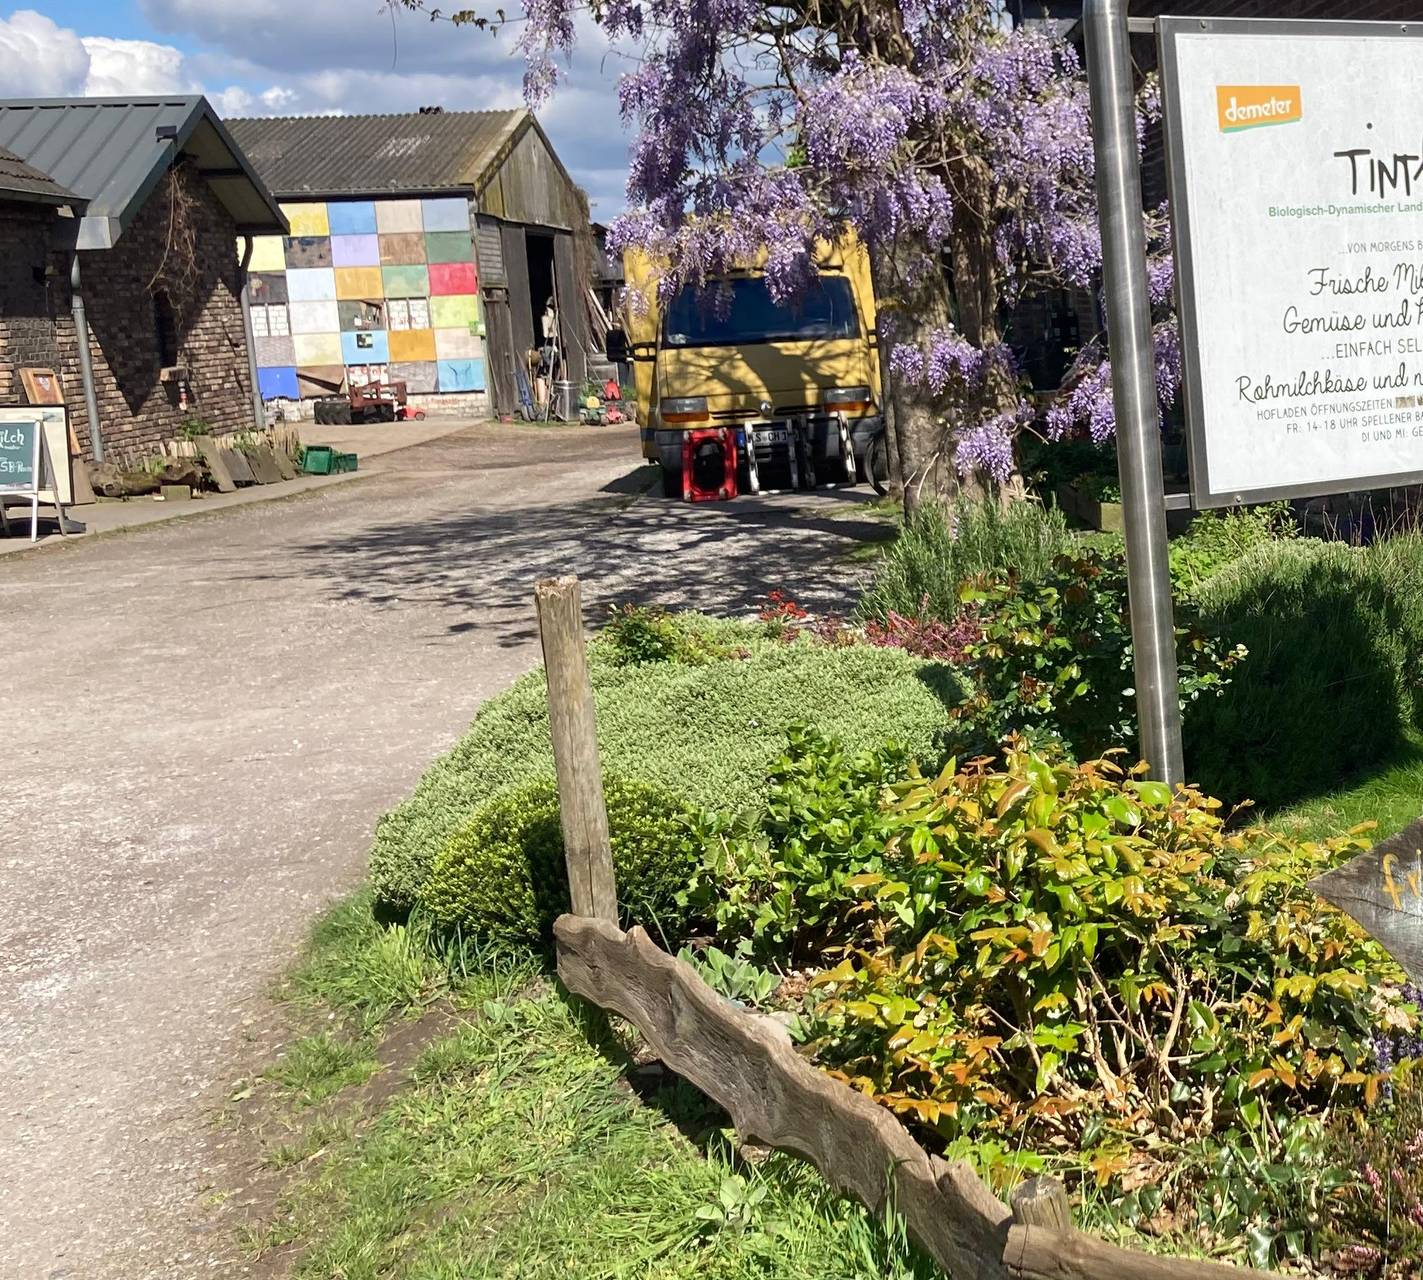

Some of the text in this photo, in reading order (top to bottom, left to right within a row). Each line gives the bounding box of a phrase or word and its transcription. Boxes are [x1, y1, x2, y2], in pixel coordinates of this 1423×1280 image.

[1225, 96, 1292, 122] demeter
[1268, 203, 1395, 219] Biologisch-Dynamischer
[1370, 240, 1415, 252] MORGENS
[1307, 266, 1389, 296] Frische
[1283, 305, 1366, 334] Gemüse
[1372, 299, 1412, 329] und
[1321, 340, 1392, 360] ...EINFACH
[1235, 368, 1368, 404] Rohmilchkäse
[1373, 361, 1409, 390] und
[1256, 398, 1393, 421] HOFLADEN ÖFFNUNGSZEITEN
[1339, 416, 1358, 429] UHR
[1361, 411, 1412, 427] SPELLENER
[0, 428, 25, 446] ilch
[1361, 431, 1370, 442] DI
[1373, 429, 1392, 441] UND
